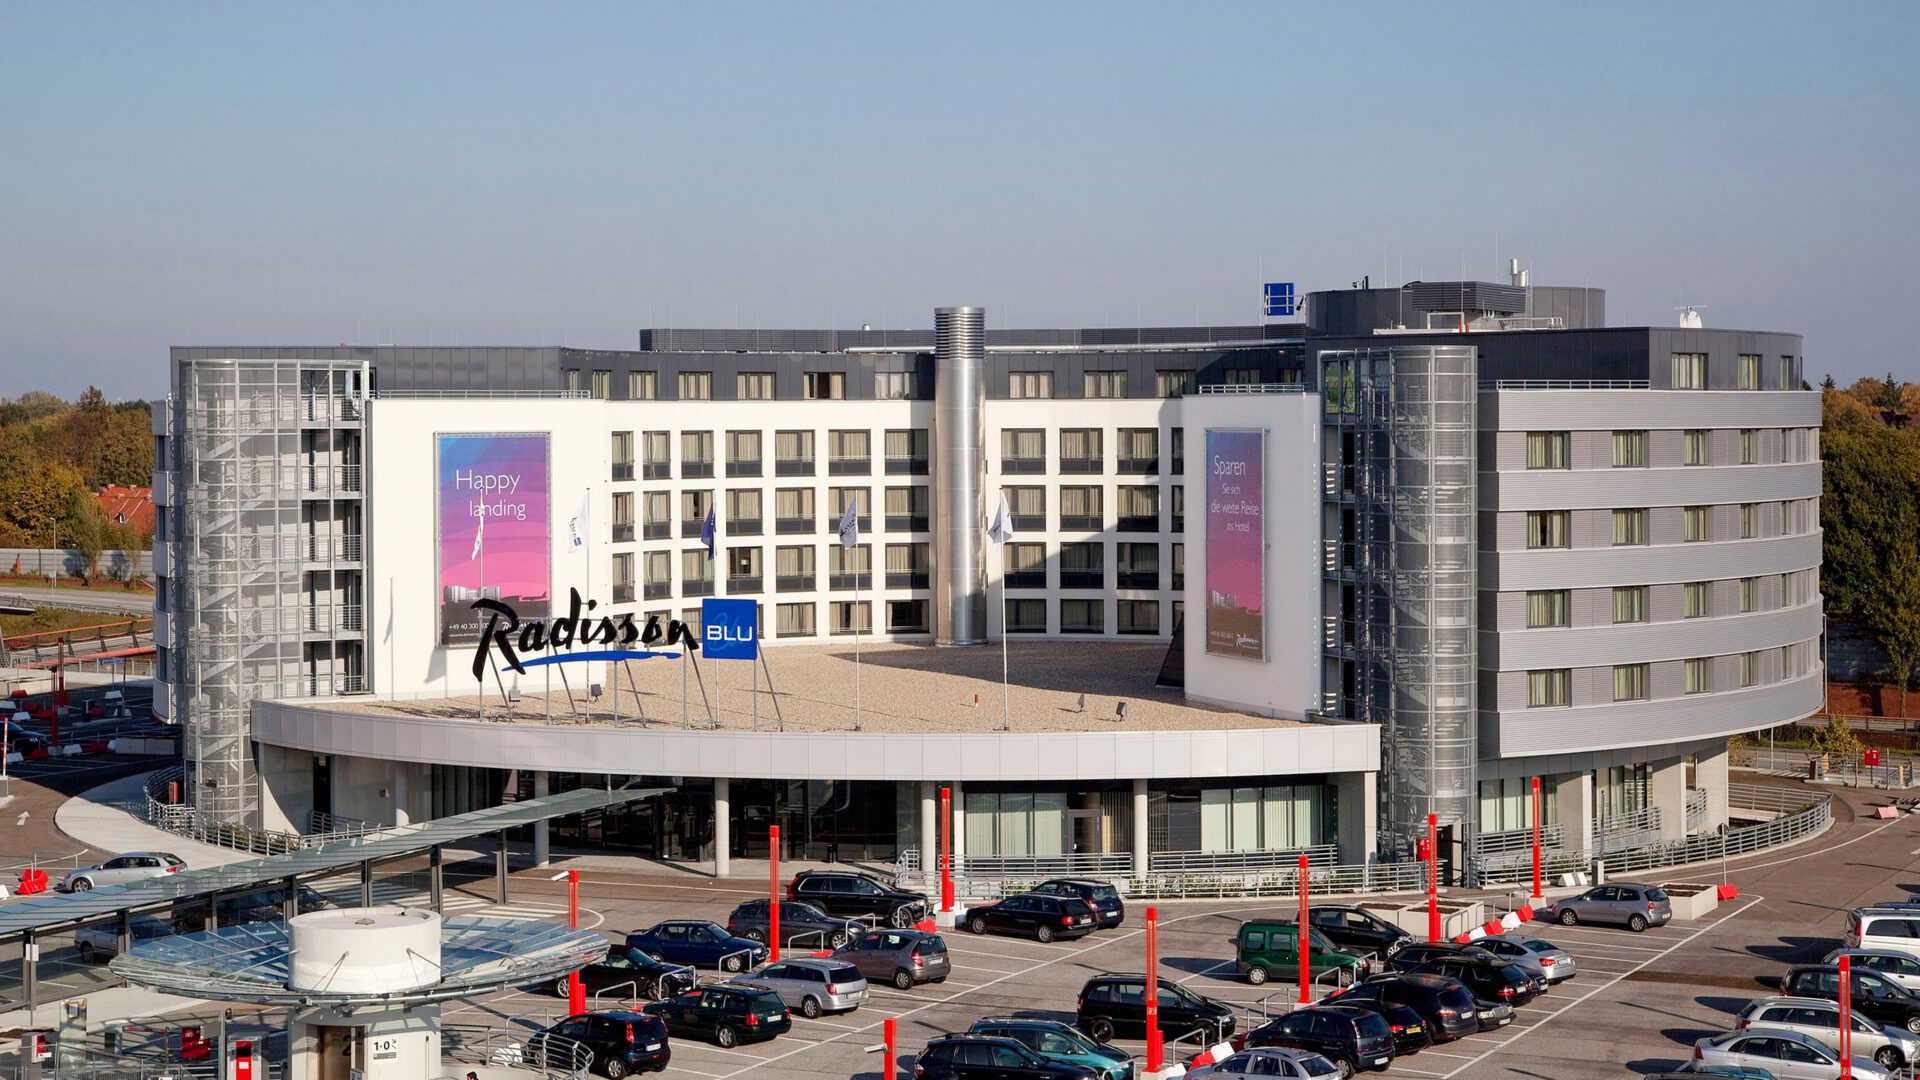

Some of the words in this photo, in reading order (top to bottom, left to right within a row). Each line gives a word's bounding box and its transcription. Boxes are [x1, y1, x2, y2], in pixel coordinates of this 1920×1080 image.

[1214, 454, 1246, 480] Sparen
[456, 469, 520, 495] Happy
[469, 499, 526, 520] landing
[471, 586, 700, 683] Radisson
[706, 624, 753, 642] BLU
